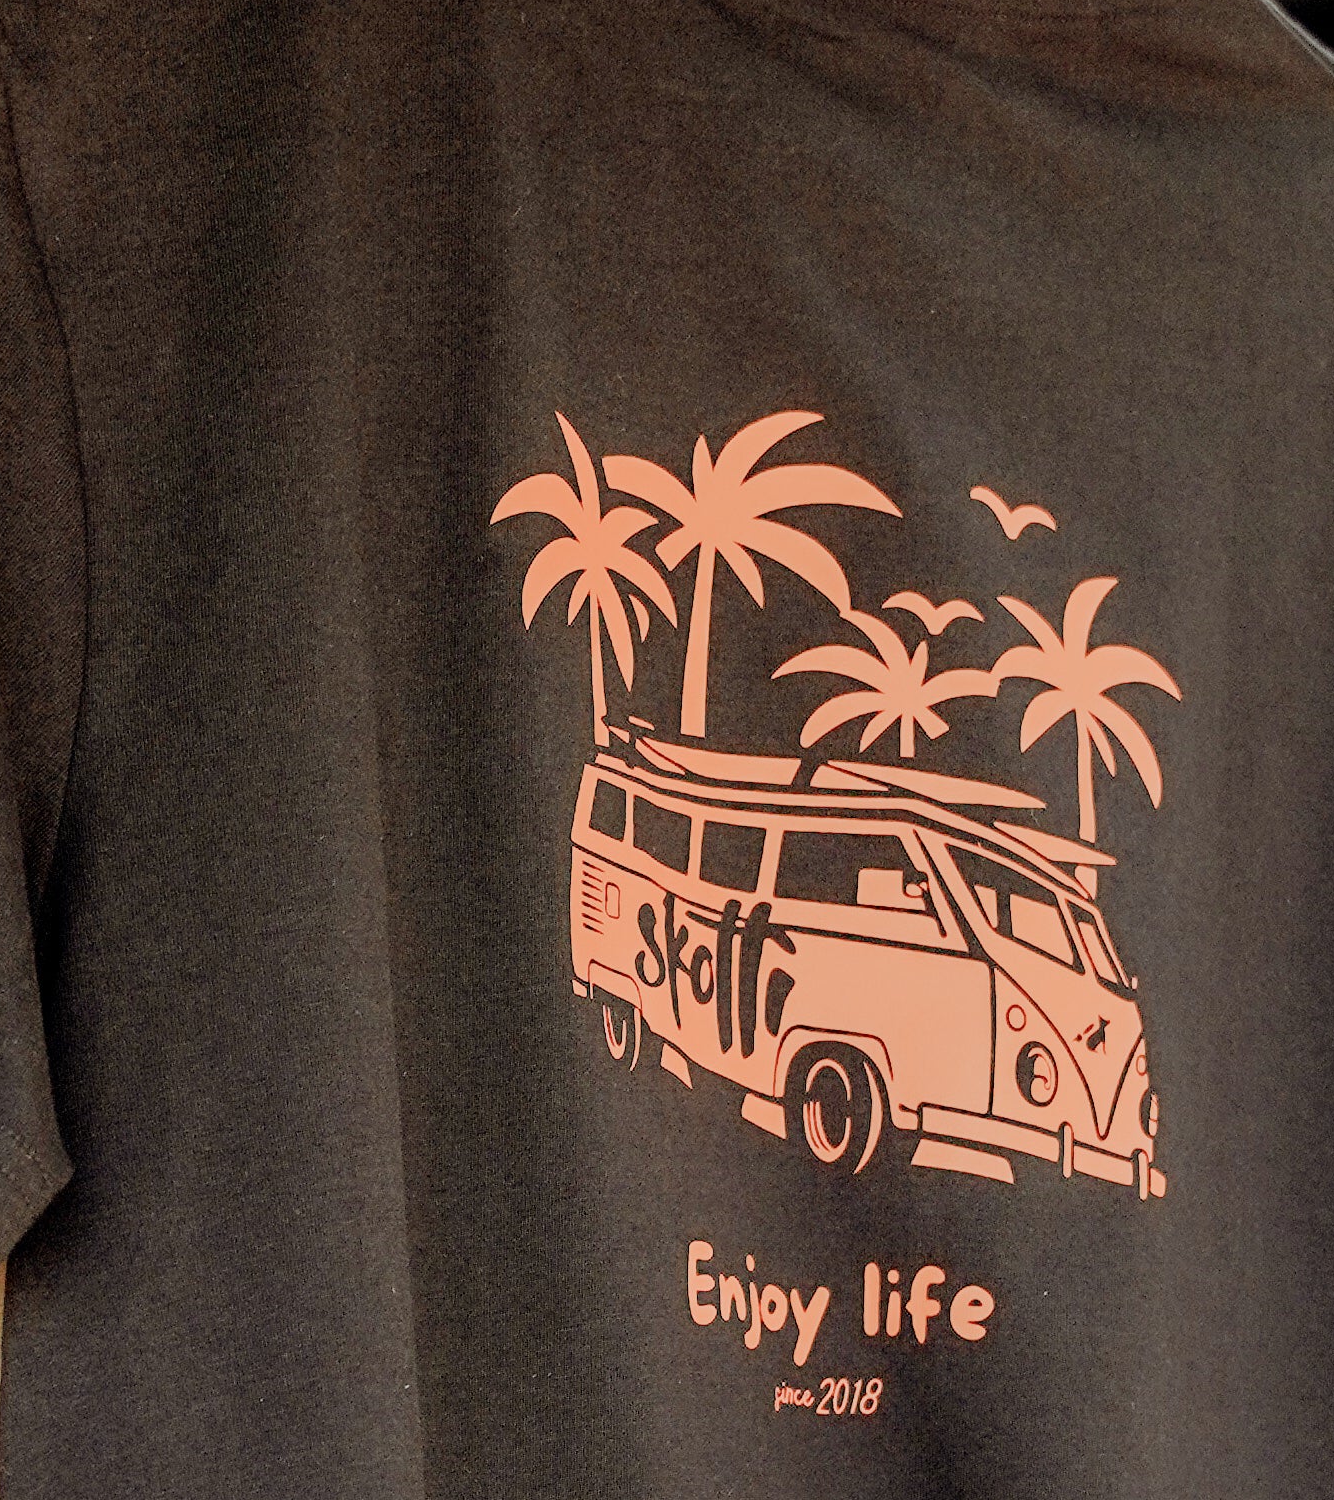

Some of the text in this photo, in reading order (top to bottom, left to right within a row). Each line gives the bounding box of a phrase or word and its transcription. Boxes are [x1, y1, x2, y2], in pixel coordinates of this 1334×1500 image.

[688, 1241, 994, 1366] Enjoy life
[815, 1377, 884, 1415] 2018
